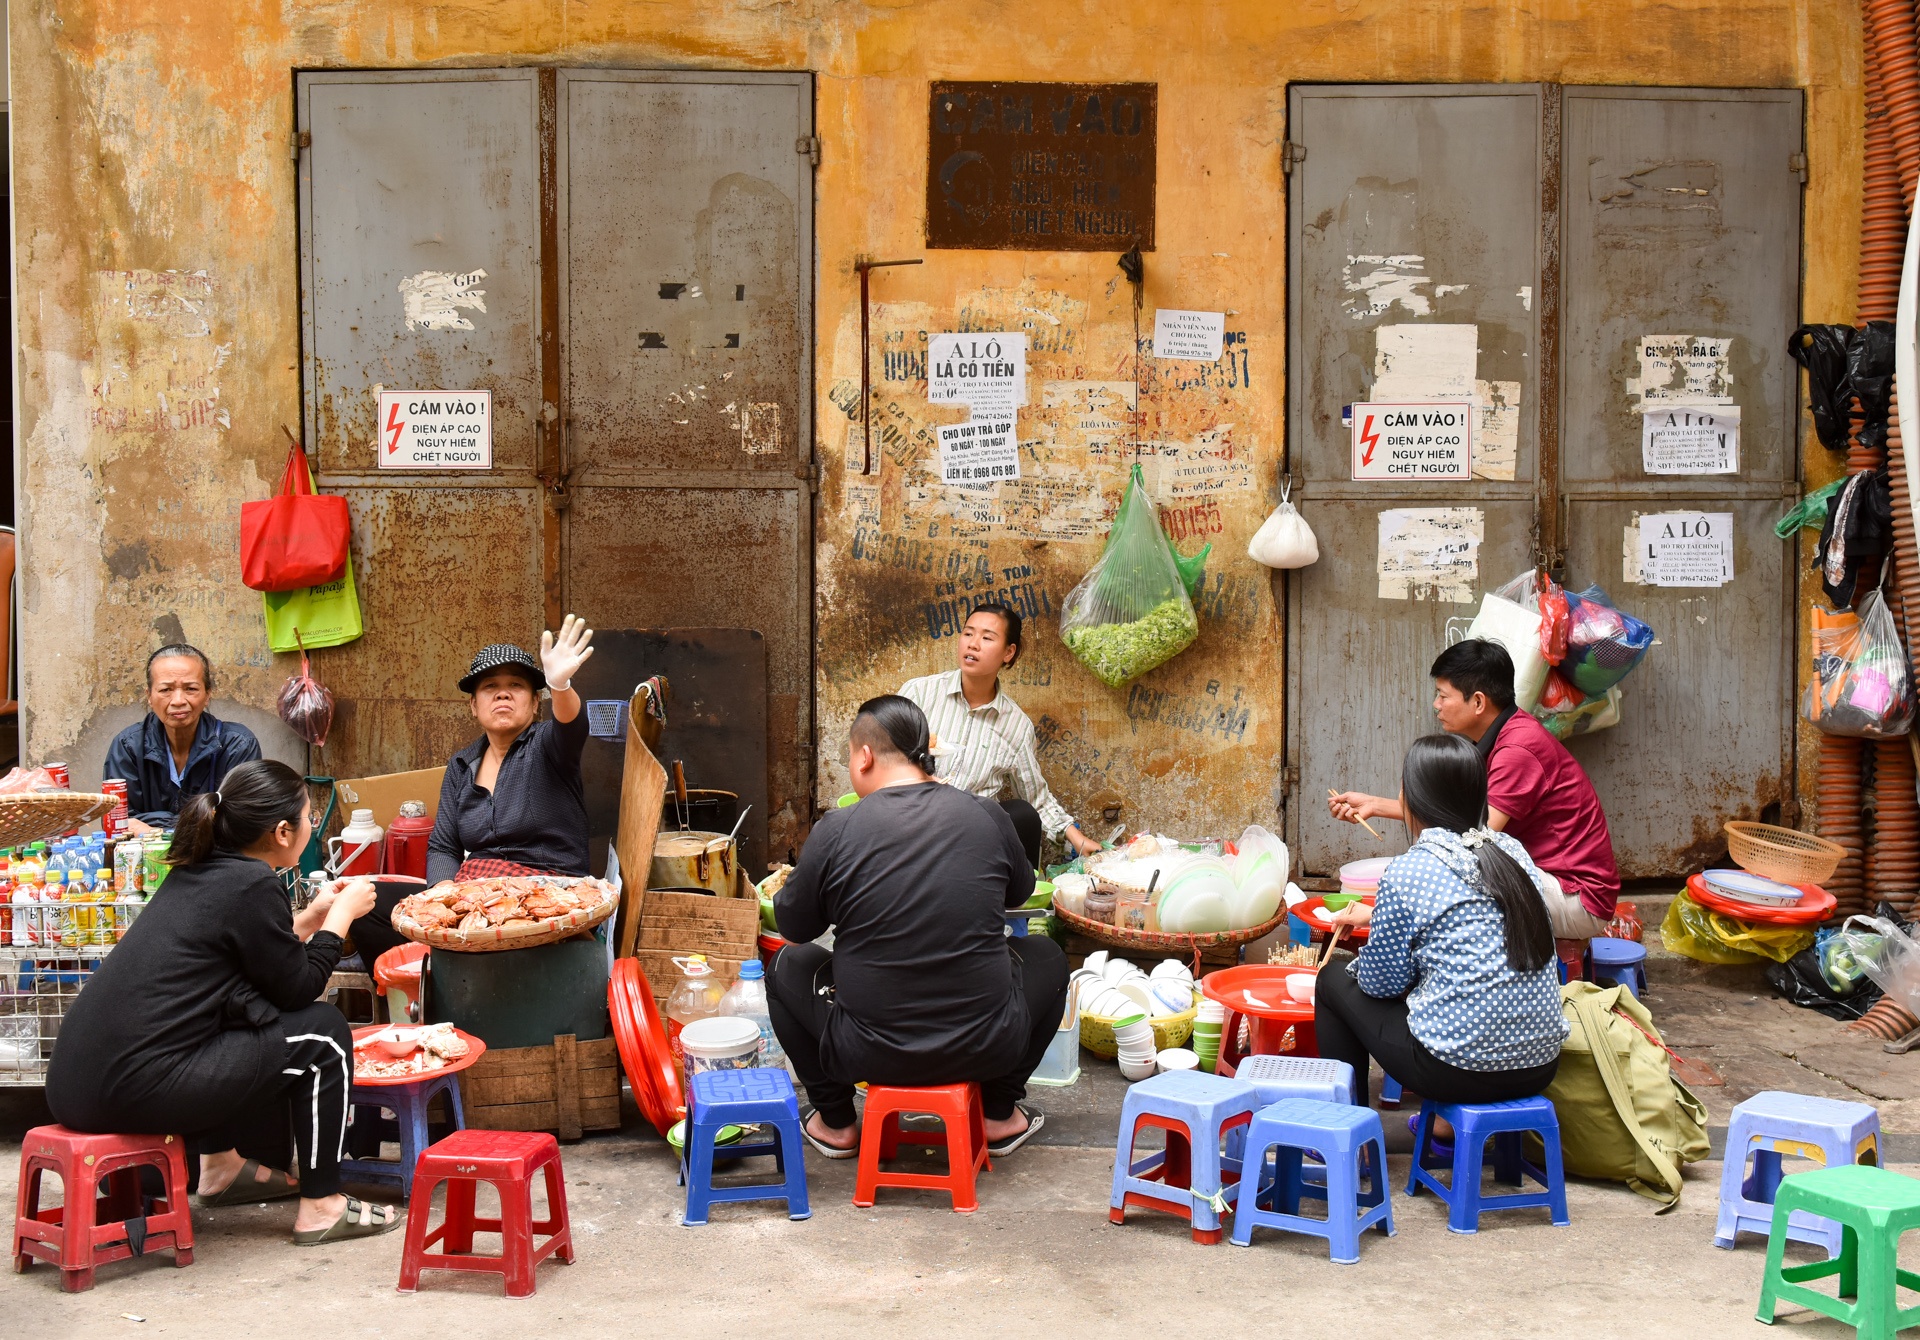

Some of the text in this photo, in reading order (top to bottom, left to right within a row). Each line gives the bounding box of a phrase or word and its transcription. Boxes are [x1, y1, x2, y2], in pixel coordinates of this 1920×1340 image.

[936, 358, 1014, 378] LÀ CÓ TIỀN
[409, 399, 484, 415] CẤM VÀO !
[1384, 411, 1418, 426] CẤM
[1423, 411, 1455, 426] VÀO
[1460, 414, 1464, 426] !
[412, 423, 480, 436] ĐIỆN ÁP CAO
[943, 422, 1011, 440] CHO VAY TRẢ GÓP
[417, 437, 476, 447] NGUY HIỂM
[951, 443, 958, 451] 60
[959, 439, 974, 450] NGÀY
[979, 439, 989, 448] 100
[991, 436, 1006, 446] NGÀY
[1388, 434, 1460, 447] ĐIỆN ÁP CAO
[413, 451, 480, 461] CHẾT NGƯỜI
[1392, 448, 1455, 459] NGUY HIỂM
[974, 467, 990, 478] 0968
[992, 466, 1003, 476] 476
[1005, 464, 1016, 475] 881
[1388, 462, 1459, 473] CHẾT NGƯỜI
[1662, 516, 1710, 539] A LÔ
